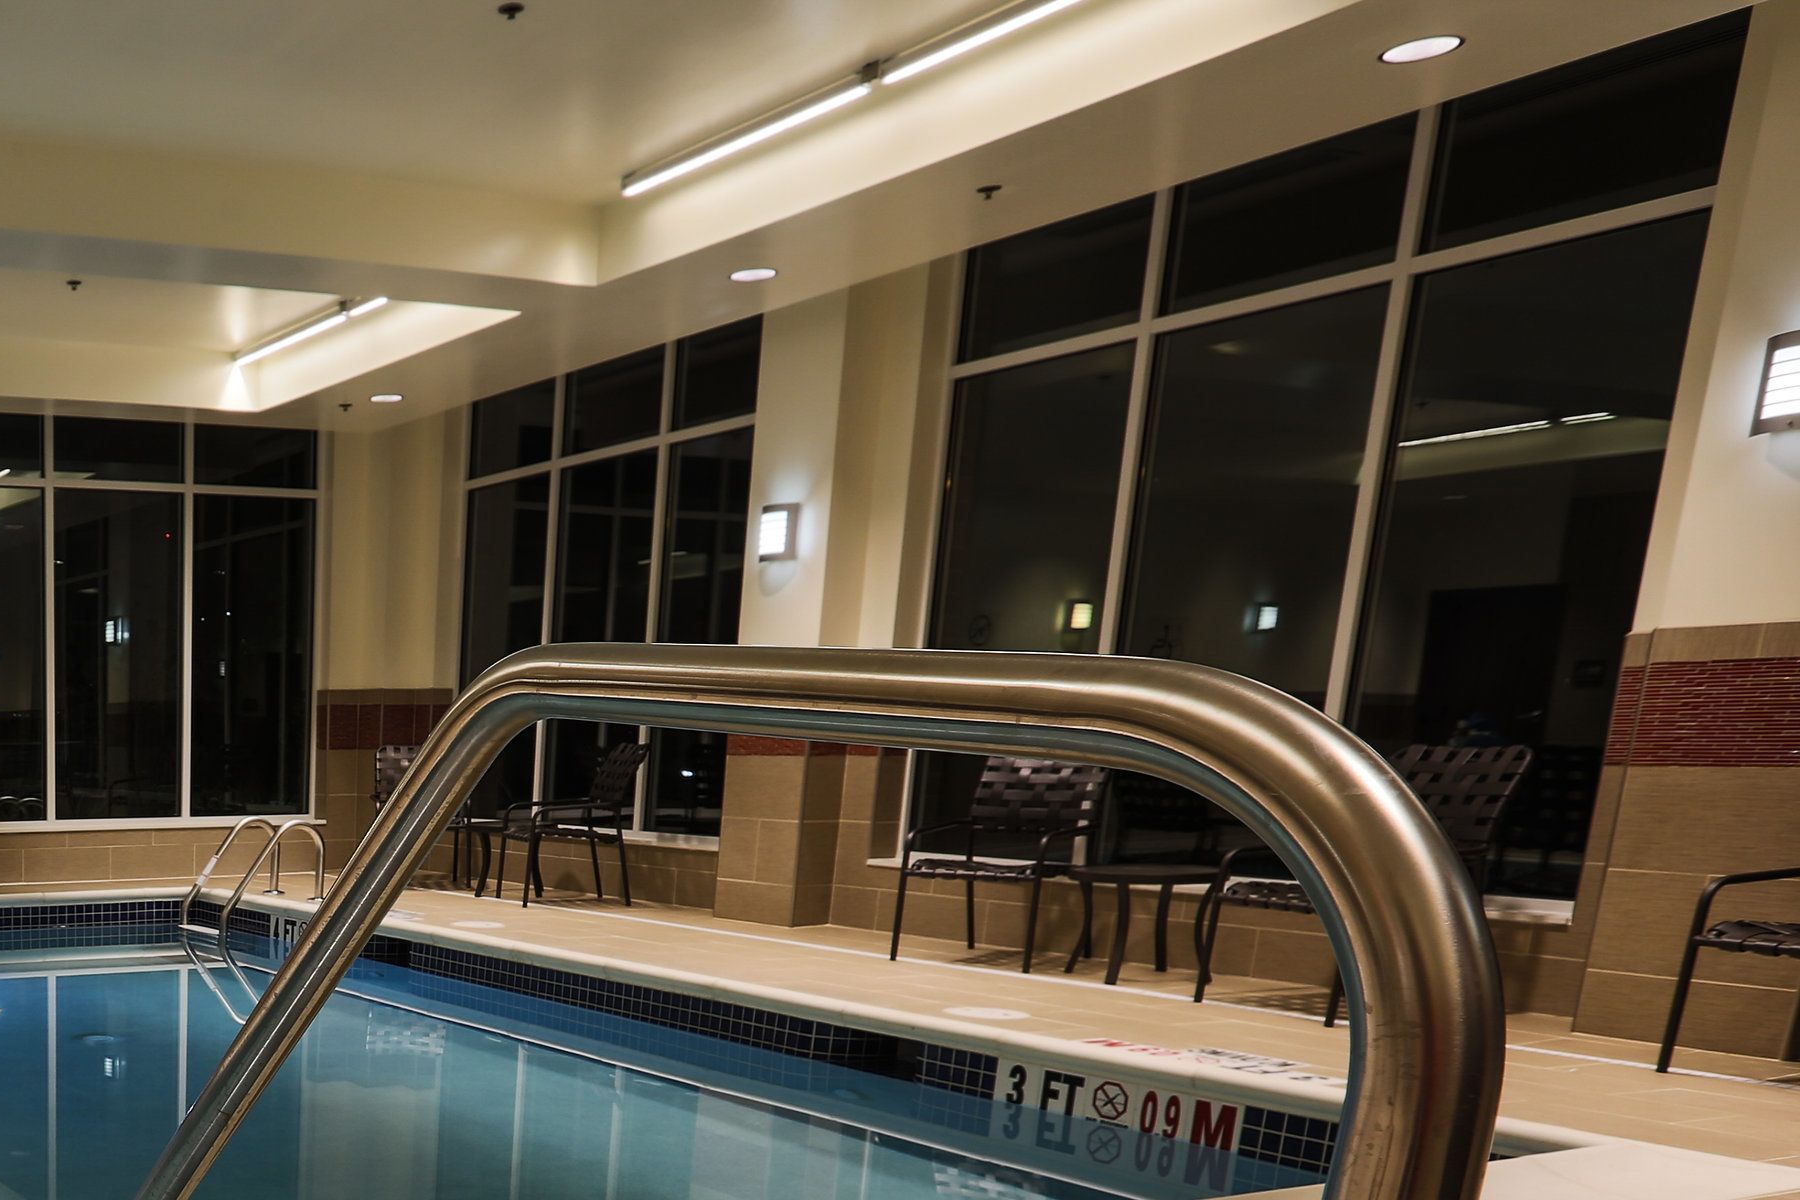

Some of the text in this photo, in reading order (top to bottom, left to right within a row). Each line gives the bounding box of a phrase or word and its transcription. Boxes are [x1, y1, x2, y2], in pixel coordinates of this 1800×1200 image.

[1006, 1064, 1027, 1105] 3
[1039, 1069, 1086, 1117] FT
[1190, 1099, 1238, 1151] M
